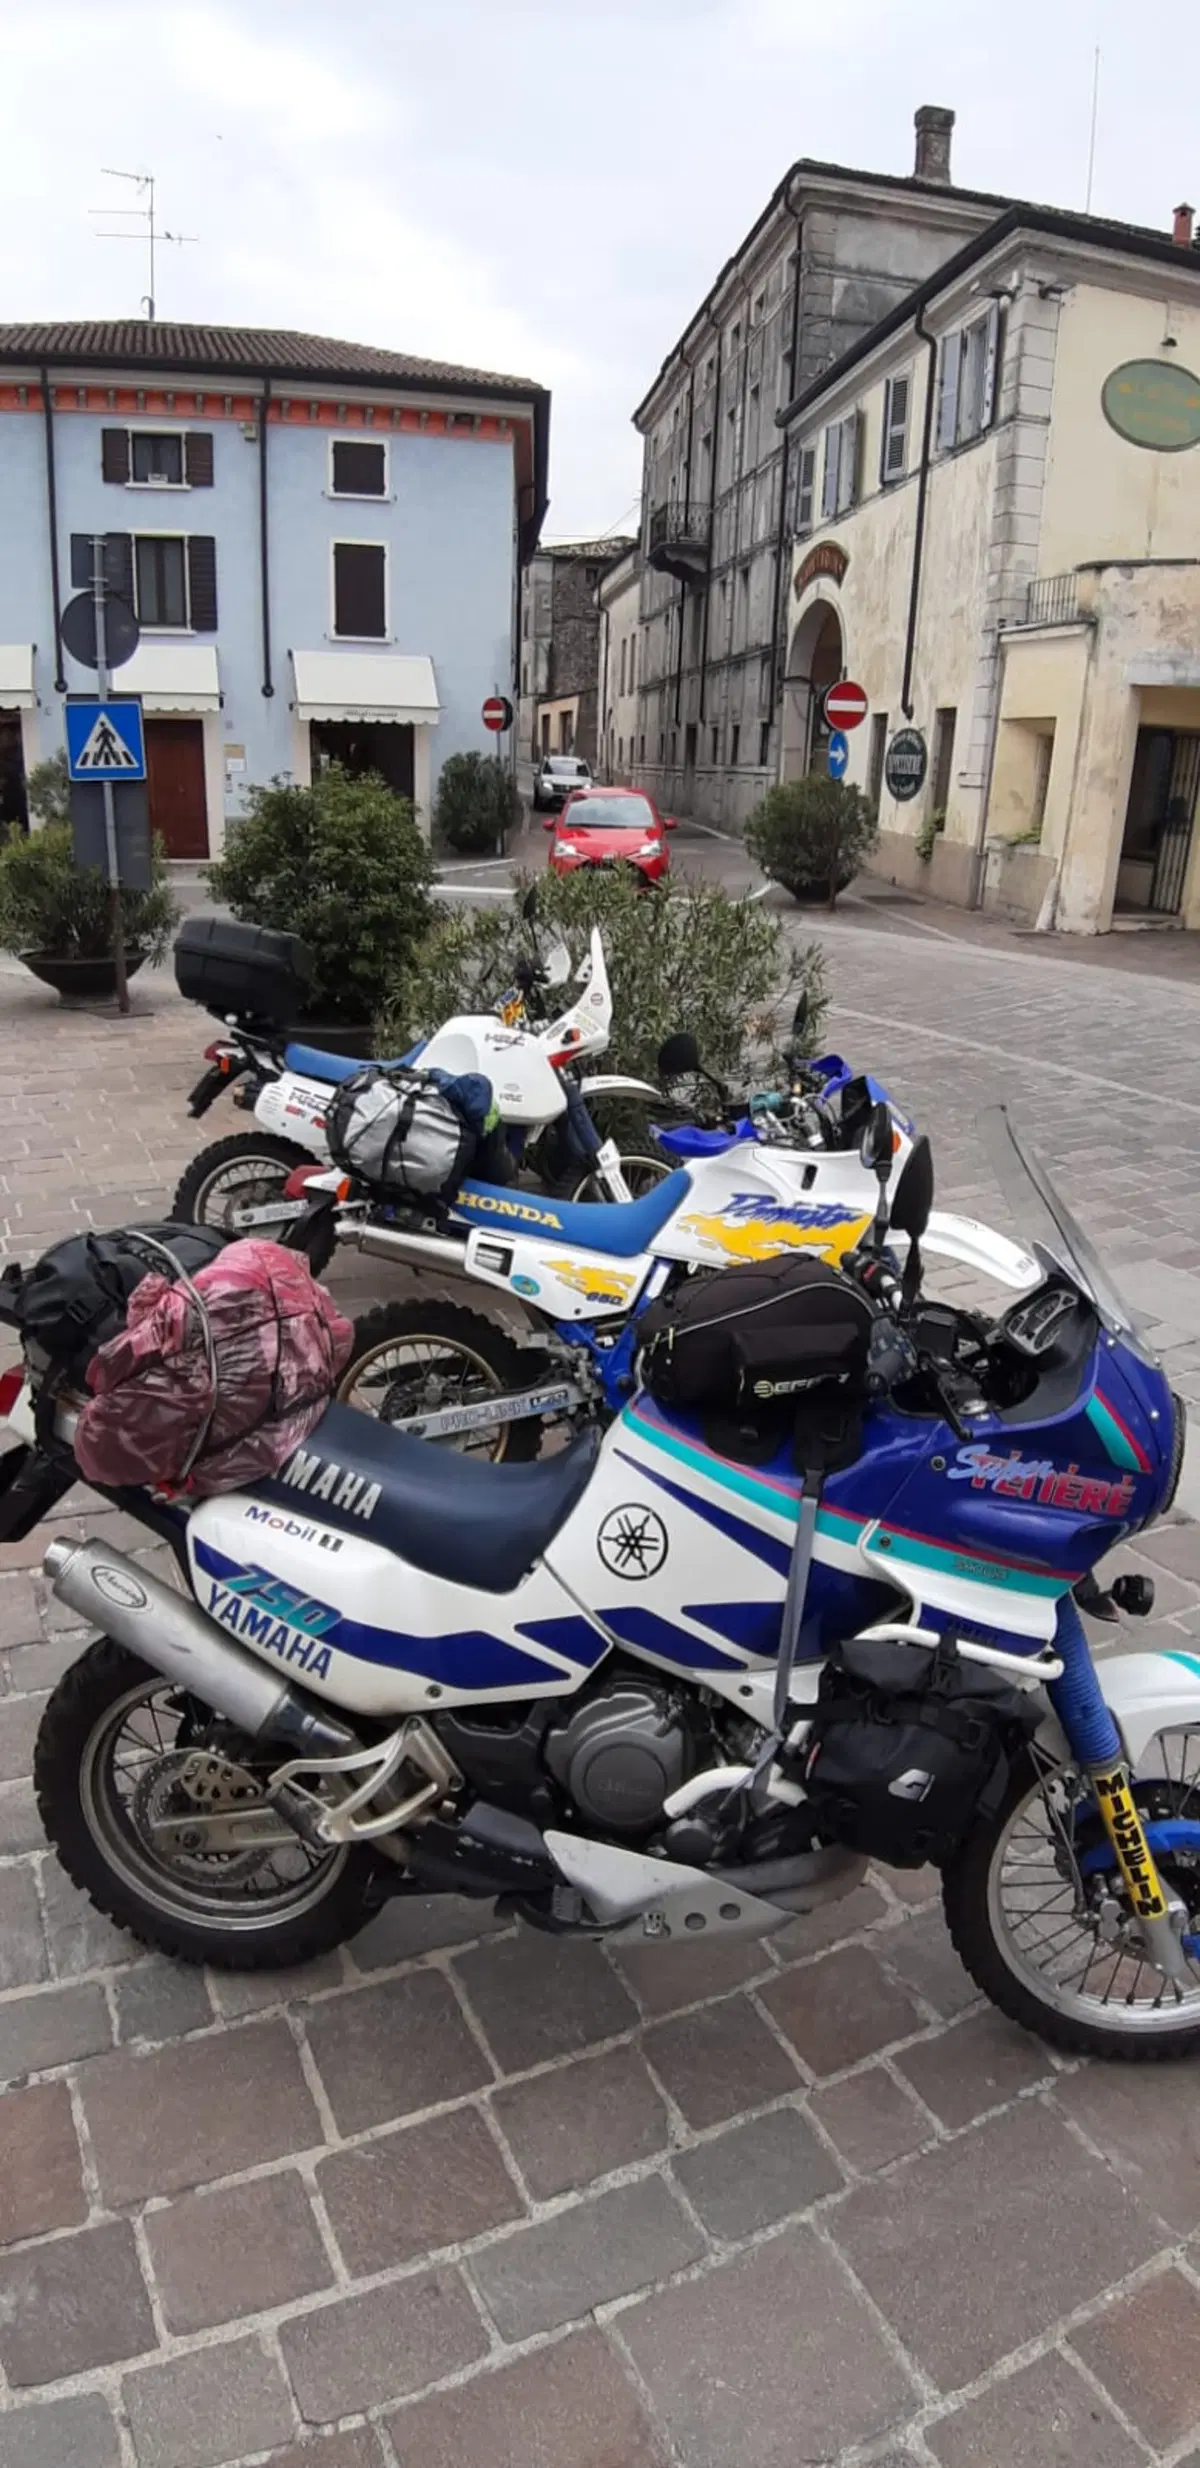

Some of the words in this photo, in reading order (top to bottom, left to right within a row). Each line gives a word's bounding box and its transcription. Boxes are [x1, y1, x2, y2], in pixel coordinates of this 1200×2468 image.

[455, 1190, 564, 1231] HONDA
[271, 1450, 383, 1520] MAHA
[244, 1505, 318, 1543] Mobil
[207, 1582, 333, 1680] YAMAHA
[220, 1562, 344, 1638] 750
[1095, 1771, 1164, 1917] MICHELIN
